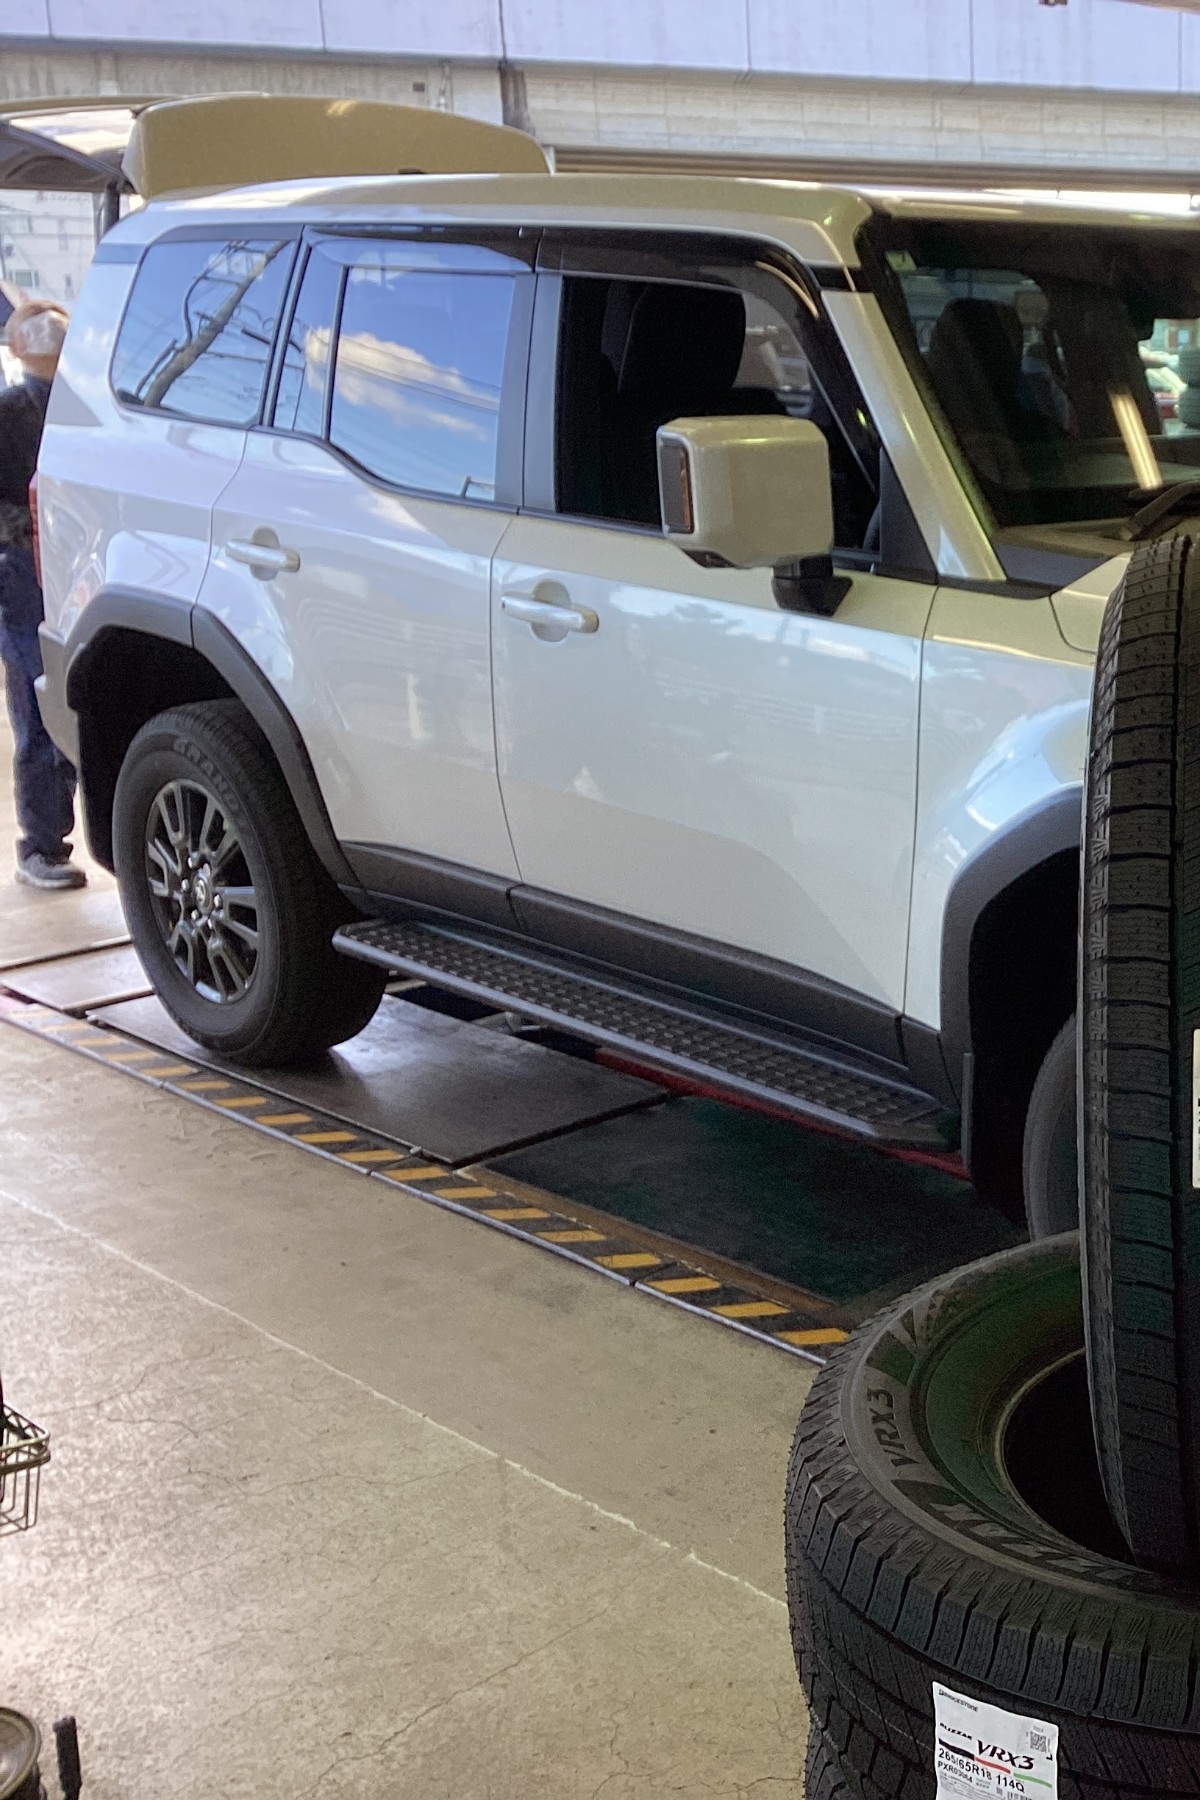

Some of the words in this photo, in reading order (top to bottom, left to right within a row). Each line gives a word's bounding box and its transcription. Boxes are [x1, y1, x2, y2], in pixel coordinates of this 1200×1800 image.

[866, 1387, 920, 1469] VRX3
[938, 1689, 978, 1713] BRIDGESTONE
[940, 1722, 972, 1740] BLIZZAK
[977, 1739, 1035, 1770] VRX3
[938, 1747, 992, 1781] 265/65R18
[996, 1775, 1025, 1793] 114Q
